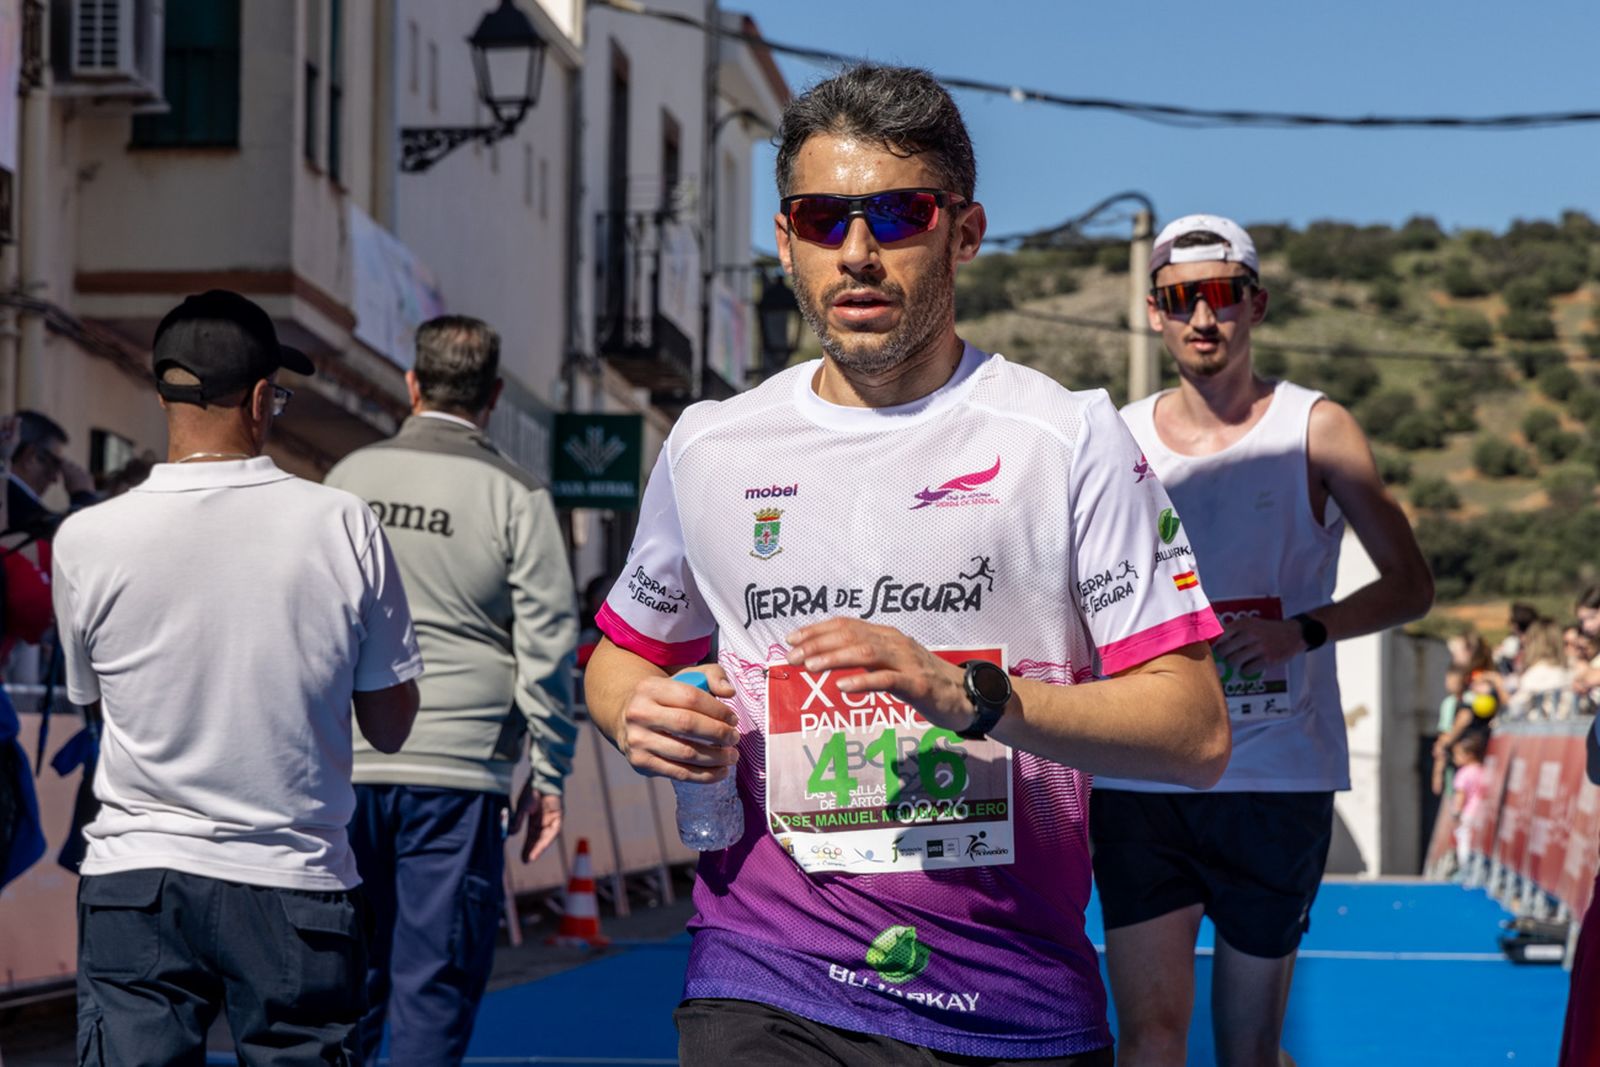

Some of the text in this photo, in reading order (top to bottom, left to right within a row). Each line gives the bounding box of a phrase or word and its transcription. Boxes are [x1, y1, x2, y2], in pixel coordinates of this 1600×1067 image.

[745, 483, 799, 500] mobel
[367, 500, 455, 538] oma
[631, 586, 679, 614] SEGURA
[744, 575, 982, 630] SIERRA DE SEGURA
[1089, 580, 1134, 618] SEGURA
[801, 670, 834, 710] X
[807, 724, 968, 807] 416
[772, 813, 811, 828] JOSE
[815, 809, 878, 827] MANUEL
[820, 795, 888, 811] DE ARTOS
[828, 963, 980, 1013] BURKAY
